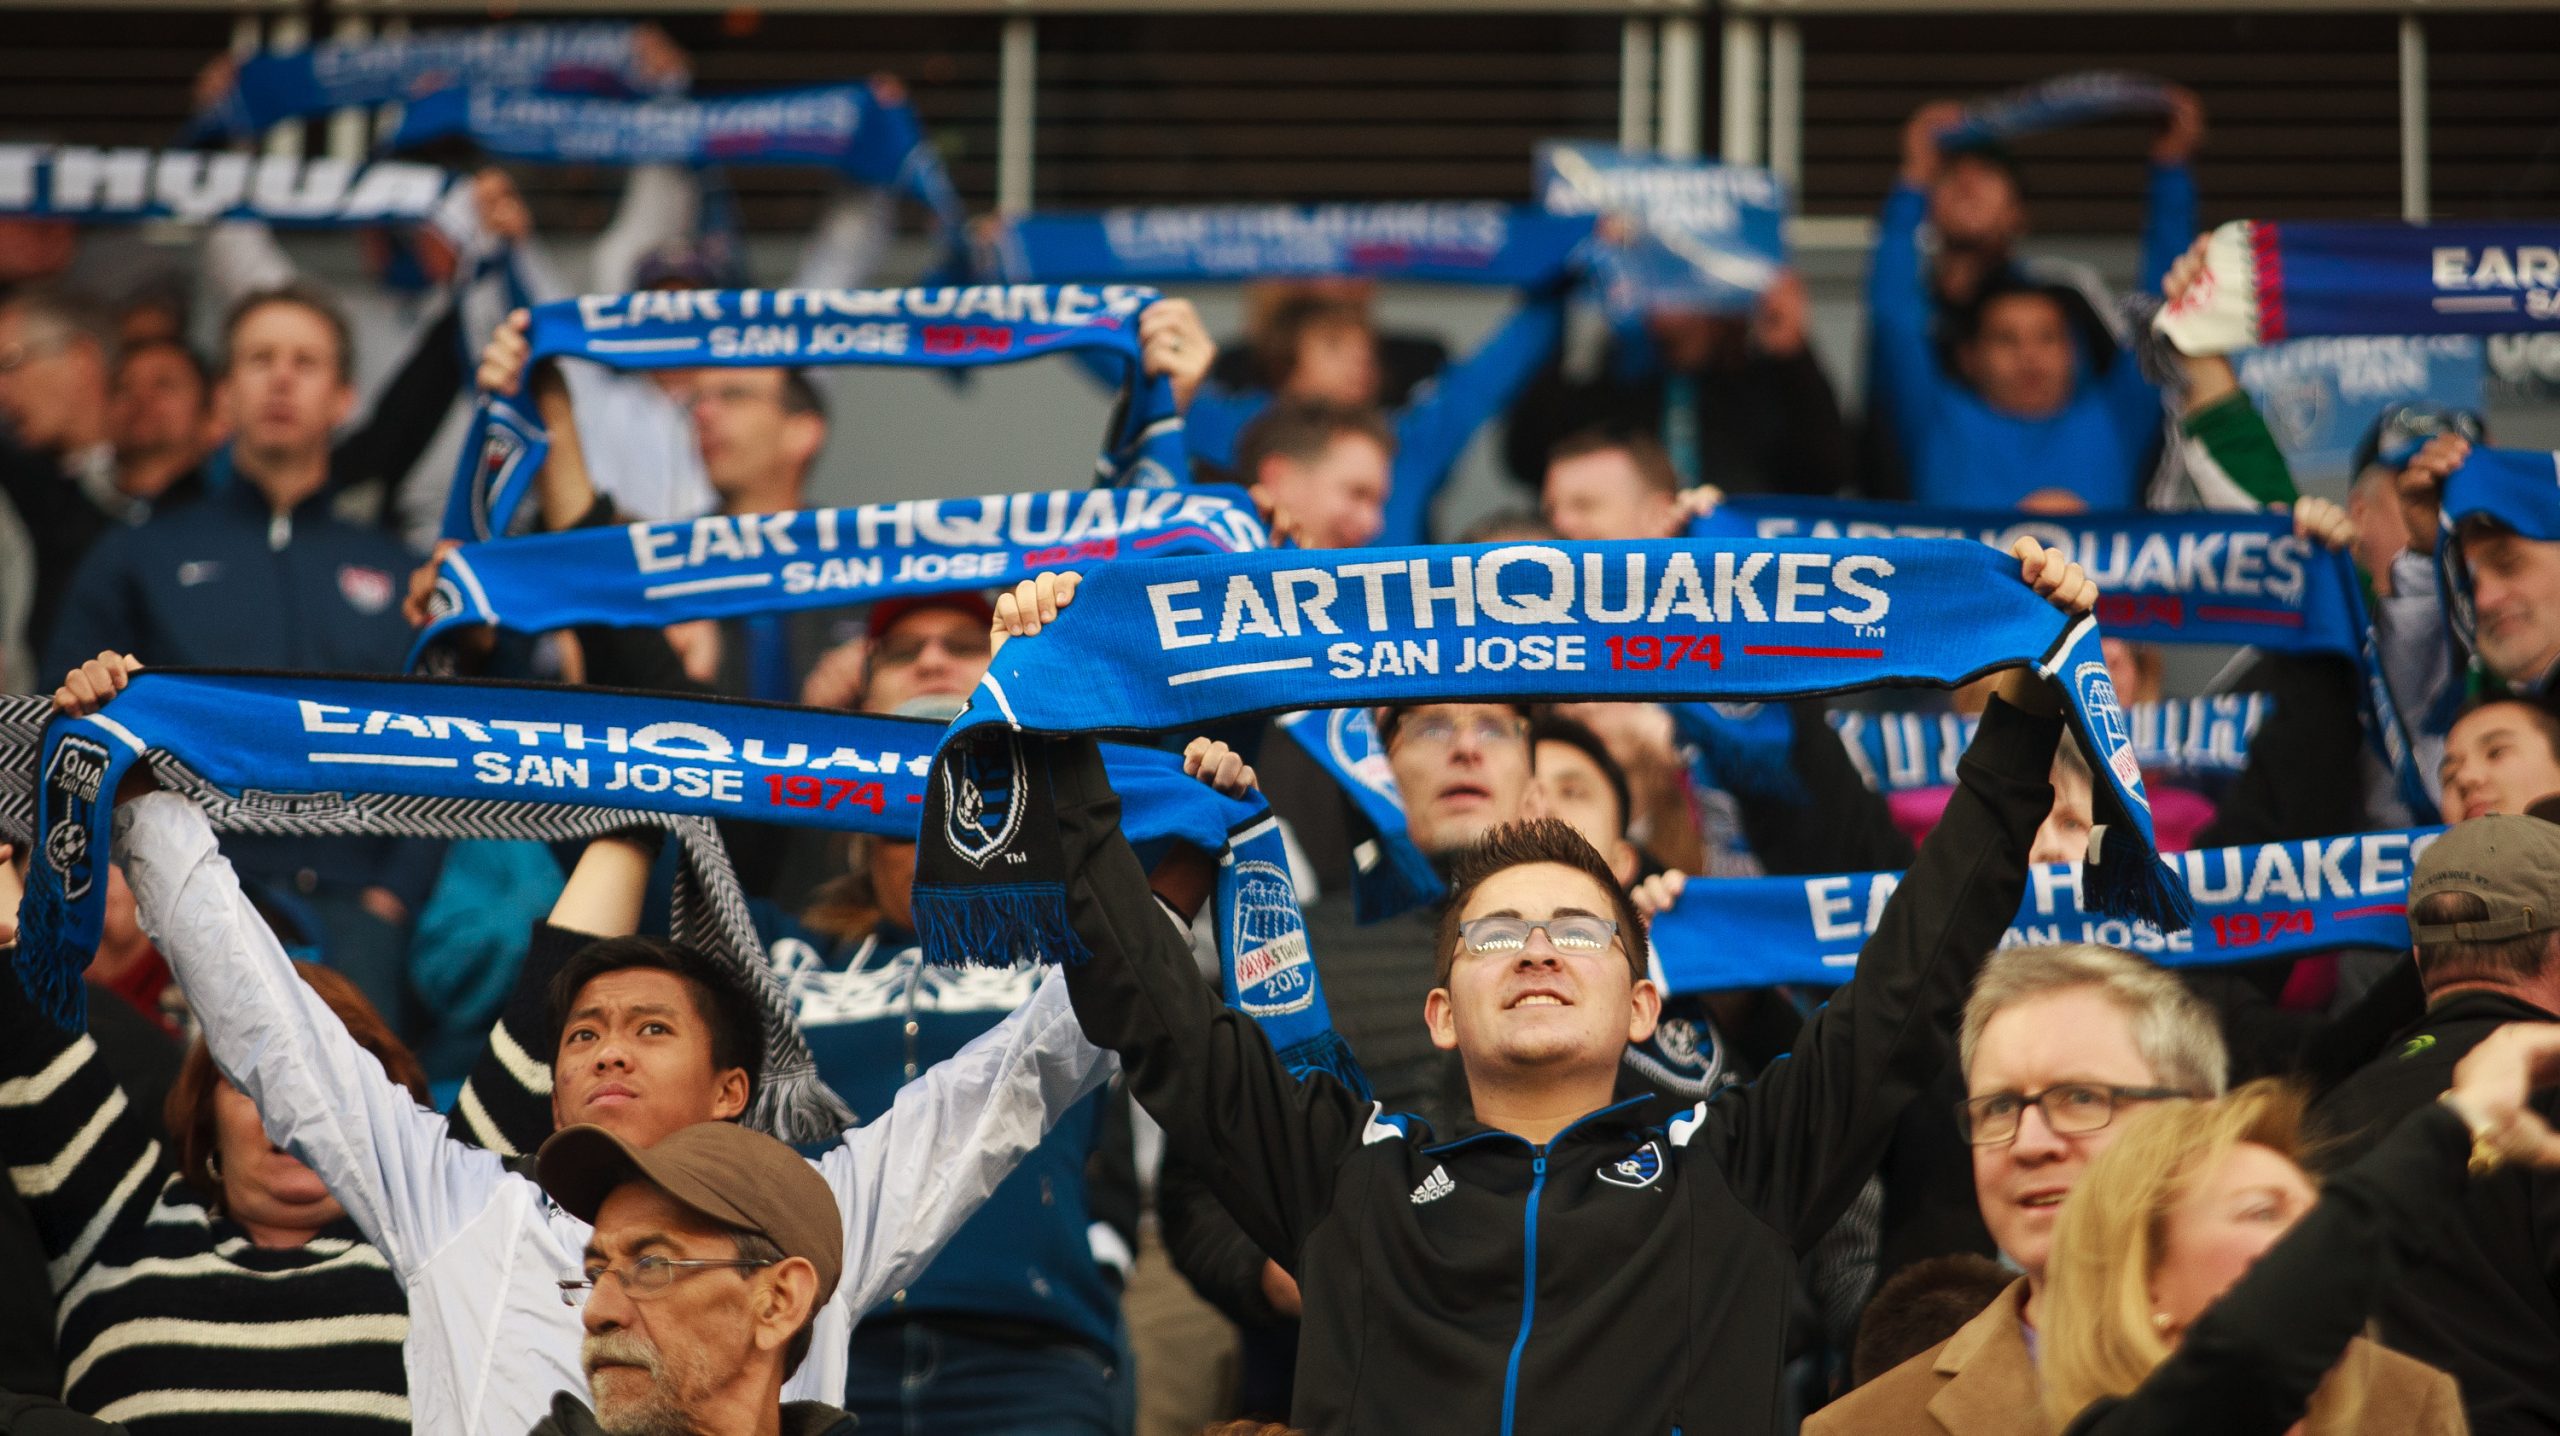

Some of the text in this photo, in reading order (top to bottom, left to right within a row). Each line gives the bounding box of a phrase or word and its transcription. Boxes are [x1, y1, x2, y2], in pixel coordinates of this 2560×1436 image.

[708, 324, 798, 357] SAN
[806, 321, 908, 355] JOSE
[627, 488, 1267, 574] EARTHQUAKES
[781, 556, 883, 595] SAN
[892, 551, 1009, 584] JOSE
[1146, 545, 1895, 650] EARTHQUAKES
[1328, 634, 1725, 679] SAN JOSE 1974
[472, 753, 887, 815] SAN JOSE 1974
[1998, 925, 2062, 950] AN
[2210, 908, 2316, 948] 1974
[1264, 966, 1305, 1000] 2015
